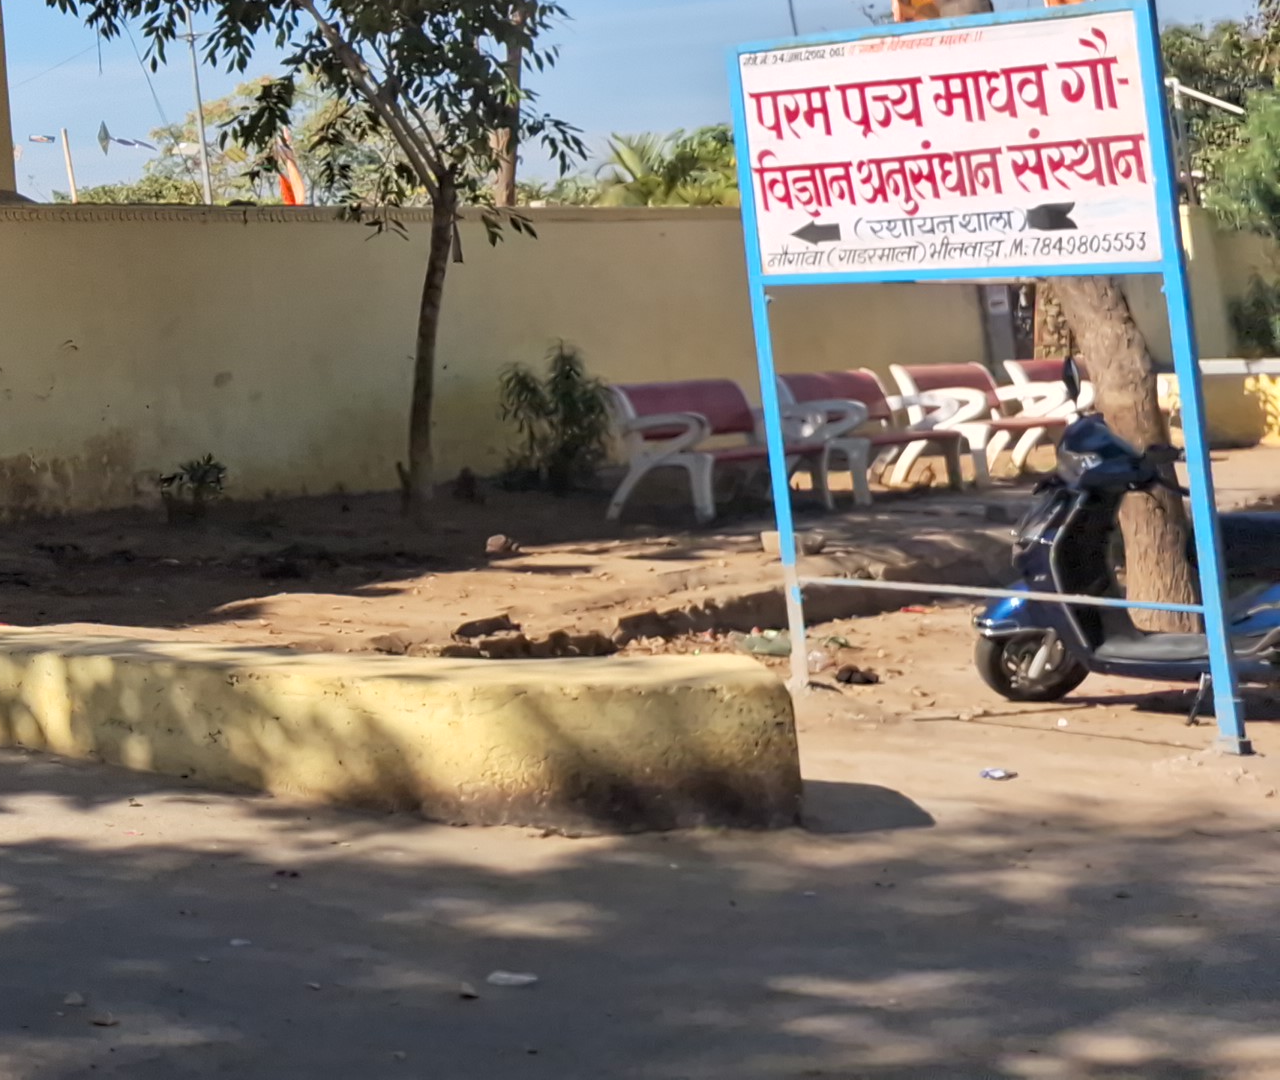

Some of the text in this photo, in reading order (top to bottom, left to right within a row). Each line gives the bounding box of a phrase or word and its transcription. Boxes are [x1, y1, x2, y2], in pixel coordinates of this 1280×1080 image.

[749, 85, 833, 141] परम
[929, 63, 1049, 123] माधव
[752, 127, 1148, 219] विज्ञान अनुसंधान संस्थान
